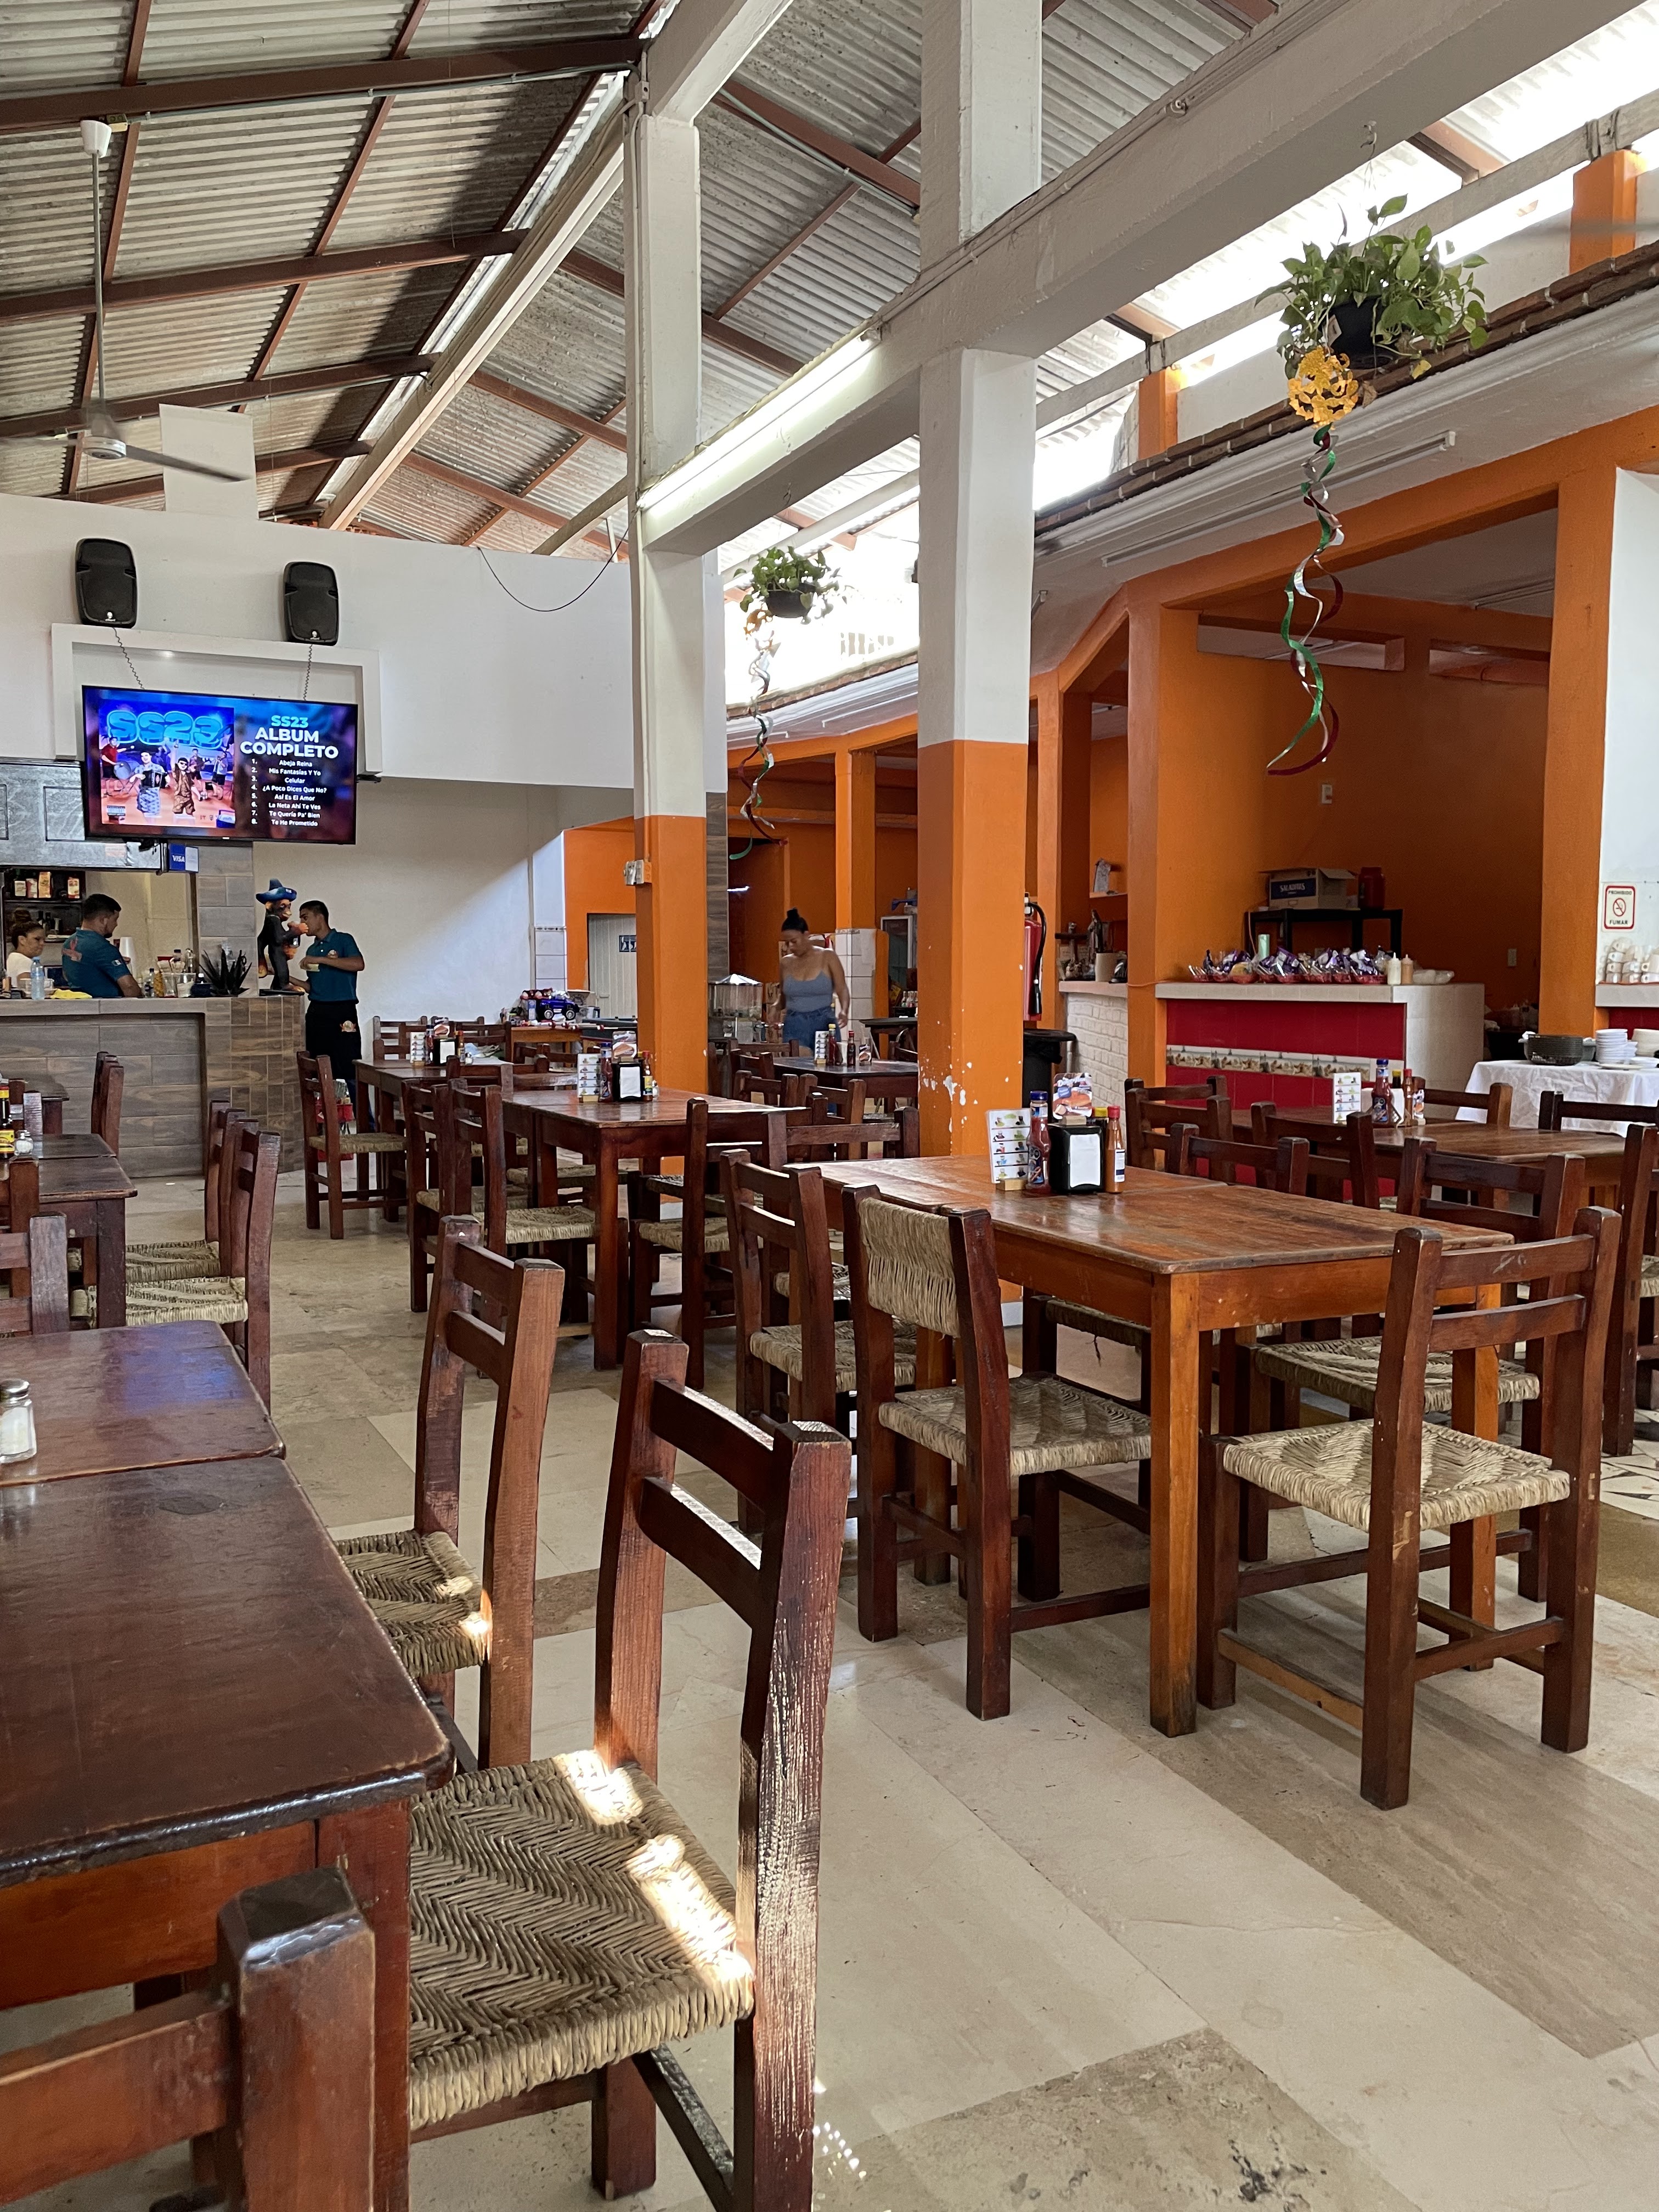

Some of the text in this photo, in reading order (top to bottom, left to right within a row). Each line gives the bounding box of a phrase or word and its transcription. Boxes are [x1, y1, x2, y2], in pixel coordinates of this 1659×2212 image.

[107, 709, 223, 749] SS23
[271, 715, 309, 728] SS23
[255, 727, 319, 743] ALBUM
[240, 741, 339, 759] COMPLETO
